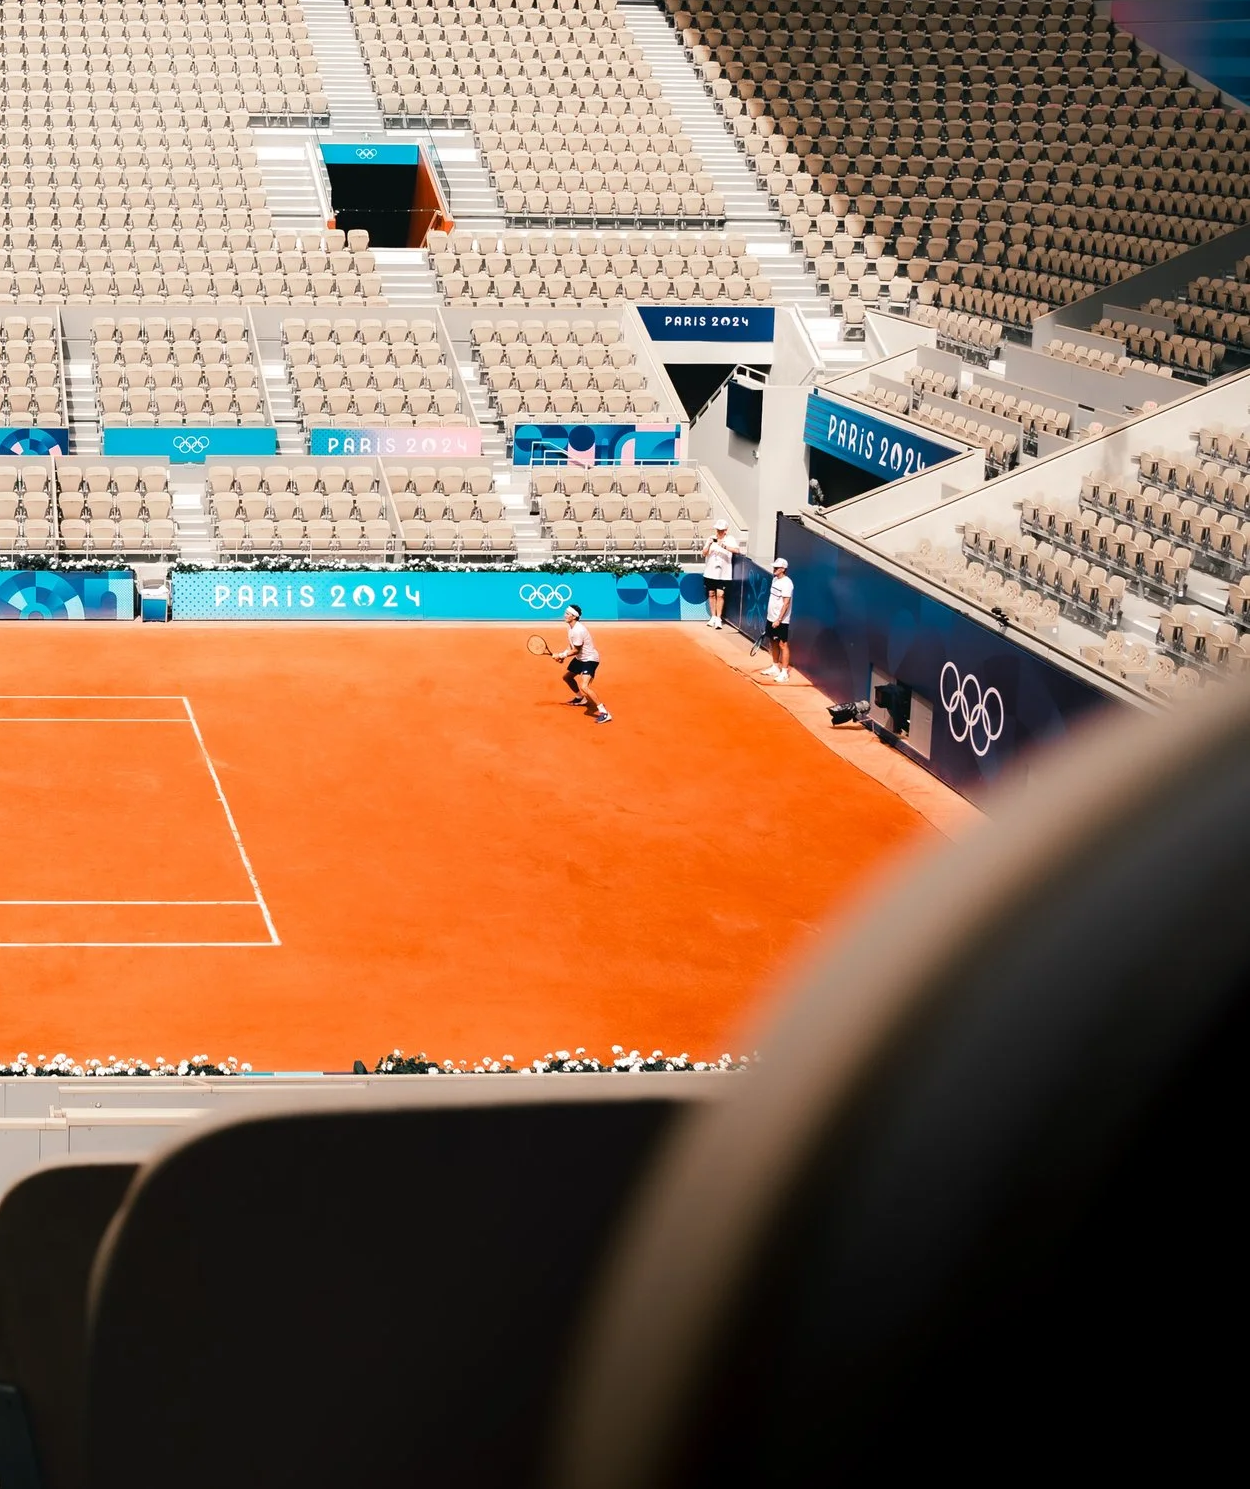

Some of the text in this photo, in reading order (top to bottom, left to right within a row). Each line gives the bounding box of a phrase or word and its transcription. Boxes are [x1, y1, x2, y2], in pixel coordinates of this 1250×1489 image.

[665, 316, 749, 327] PARIS 2024
[406, 438, 467, 453] 2024
[330, 585, 420, 608] 2024
